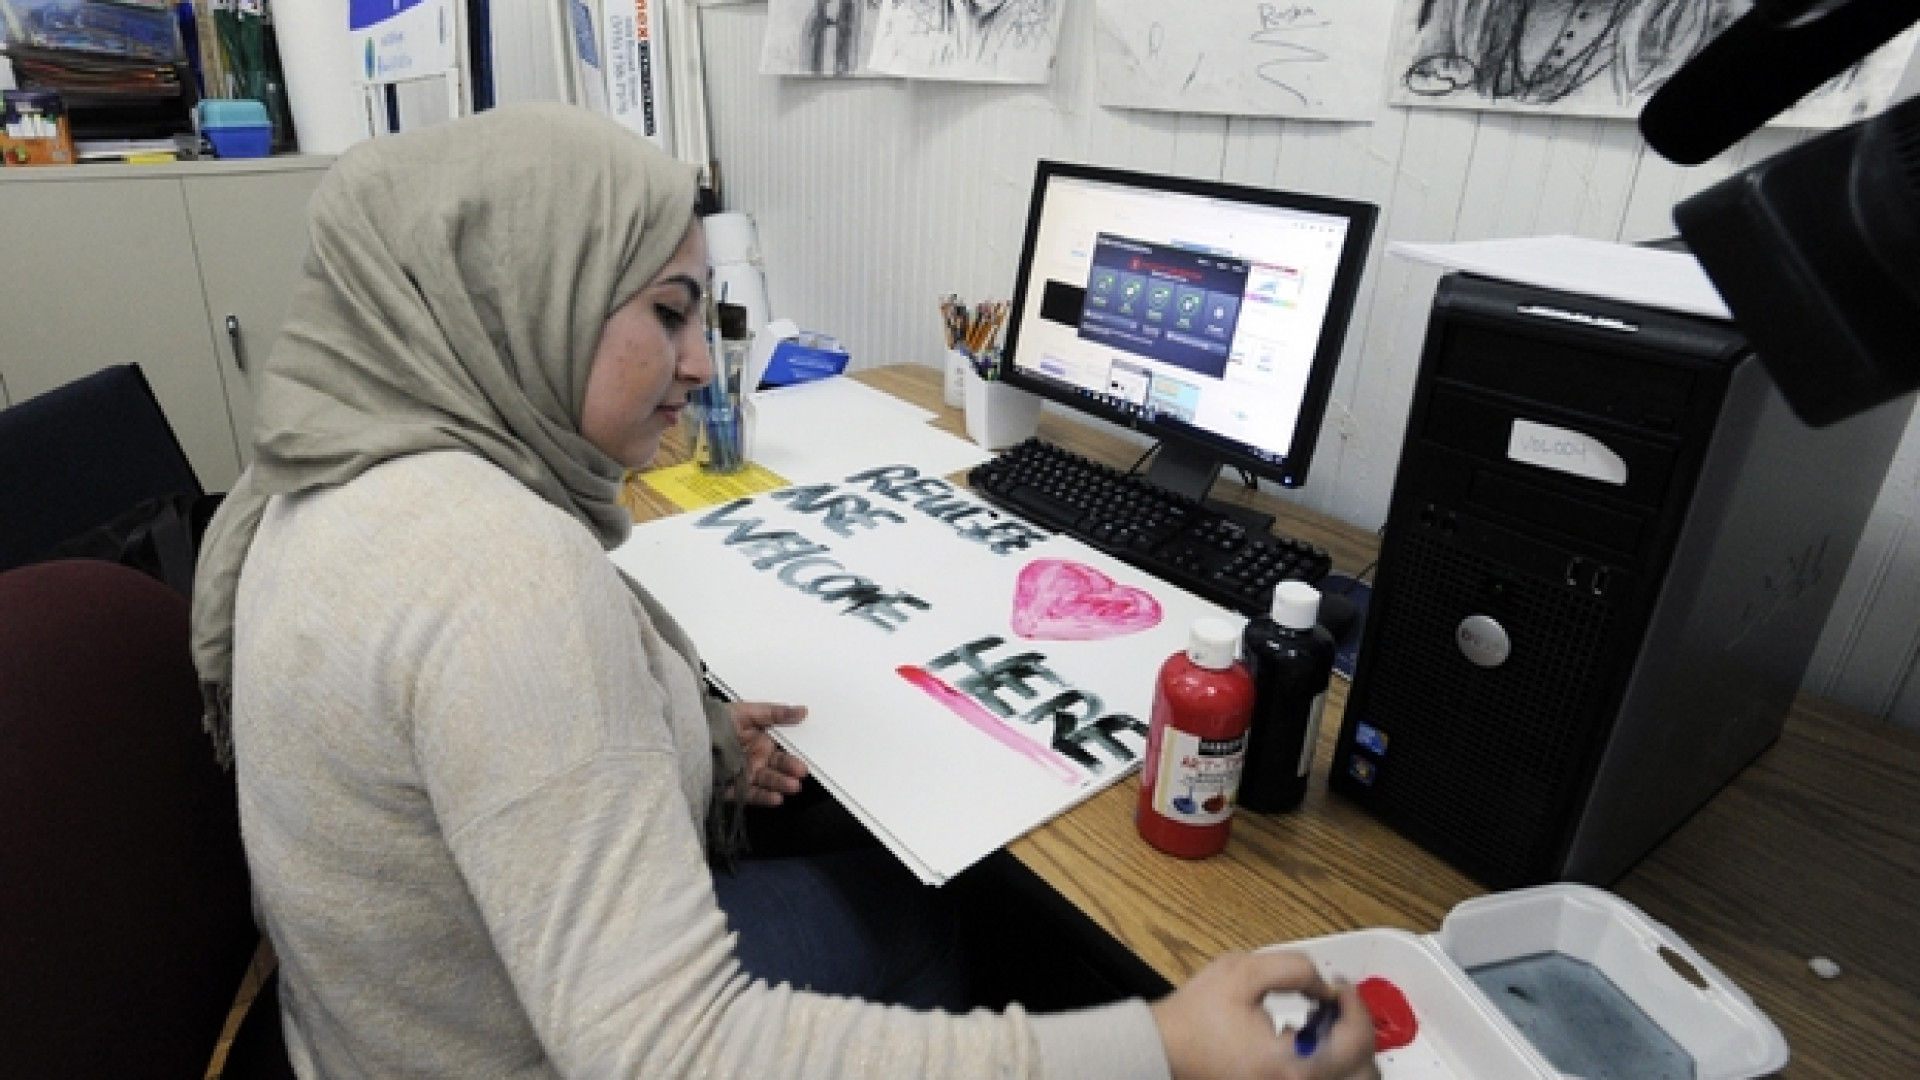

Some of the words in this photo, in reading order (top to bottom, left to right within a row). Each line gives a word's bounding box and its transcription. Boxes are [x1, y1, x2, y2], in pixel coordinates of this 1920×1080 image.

[694, 498, 932, 632] WELCOME
[771, 482, 907, 538] ARE
[926, 634, 1149, 773] HERE
